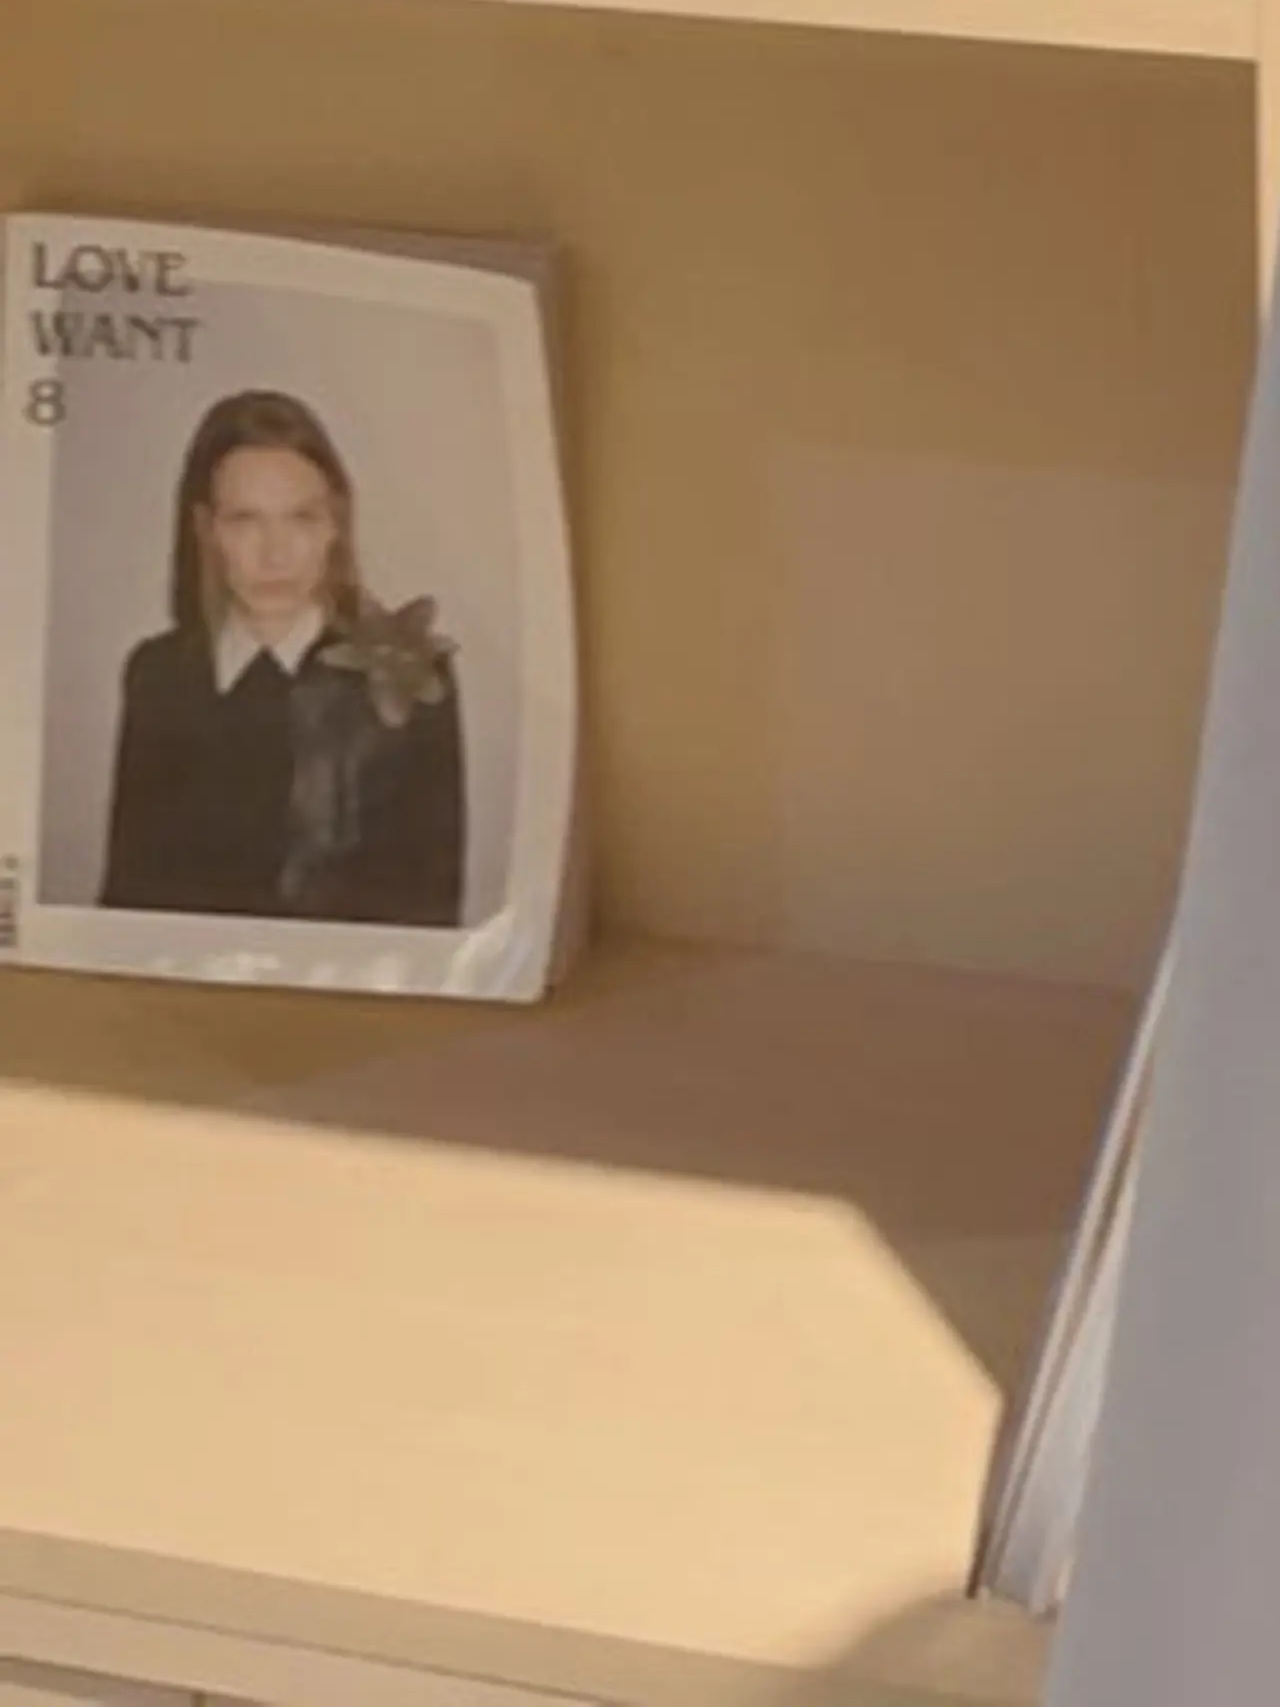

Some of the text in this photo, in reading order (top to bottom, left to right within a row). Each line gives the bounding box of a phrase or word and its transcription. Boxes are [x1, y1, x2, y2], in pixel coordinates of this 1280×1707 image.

[32, 241, 194, 298] LOVE
[29, 308, 205, 364] WANT
[23, 378, 67, 428] 8
